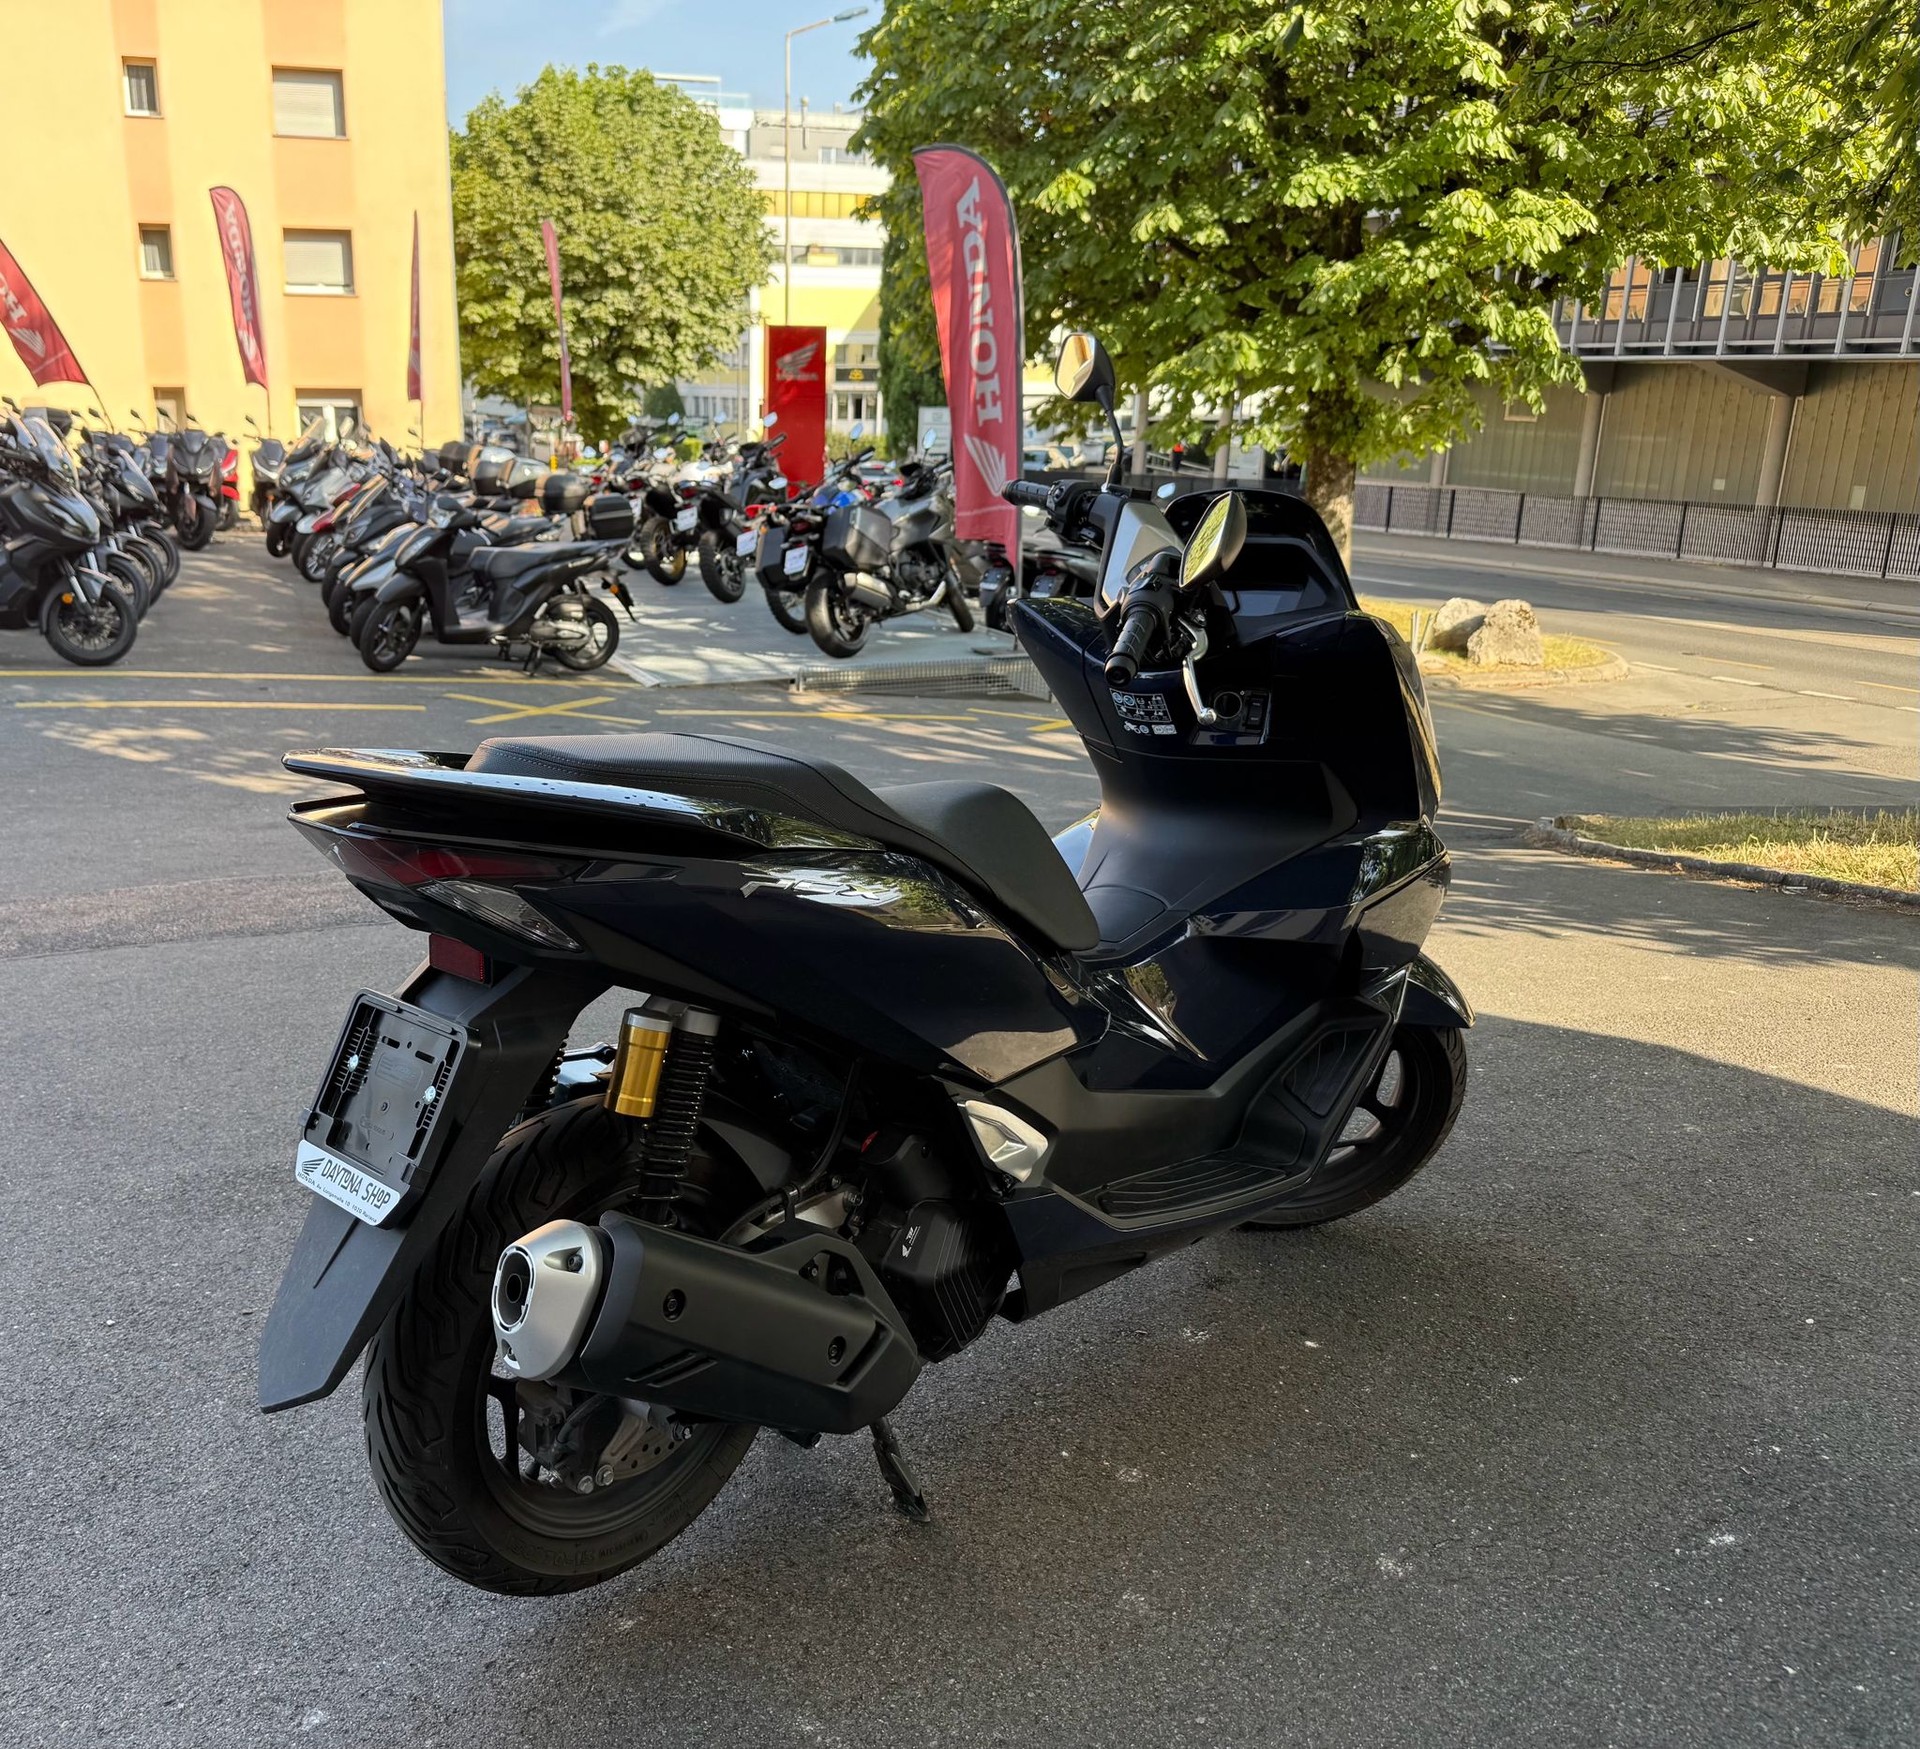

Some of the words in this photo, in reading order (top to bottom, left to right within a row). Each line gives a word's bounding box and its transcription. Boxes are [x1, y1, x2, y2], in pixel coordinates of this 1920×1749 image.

[956, 176, 1003, 427] HONDA
[321, 1159, 364, 1197] DAYTONA
[361, 1182, 391, 1210] SHOP
